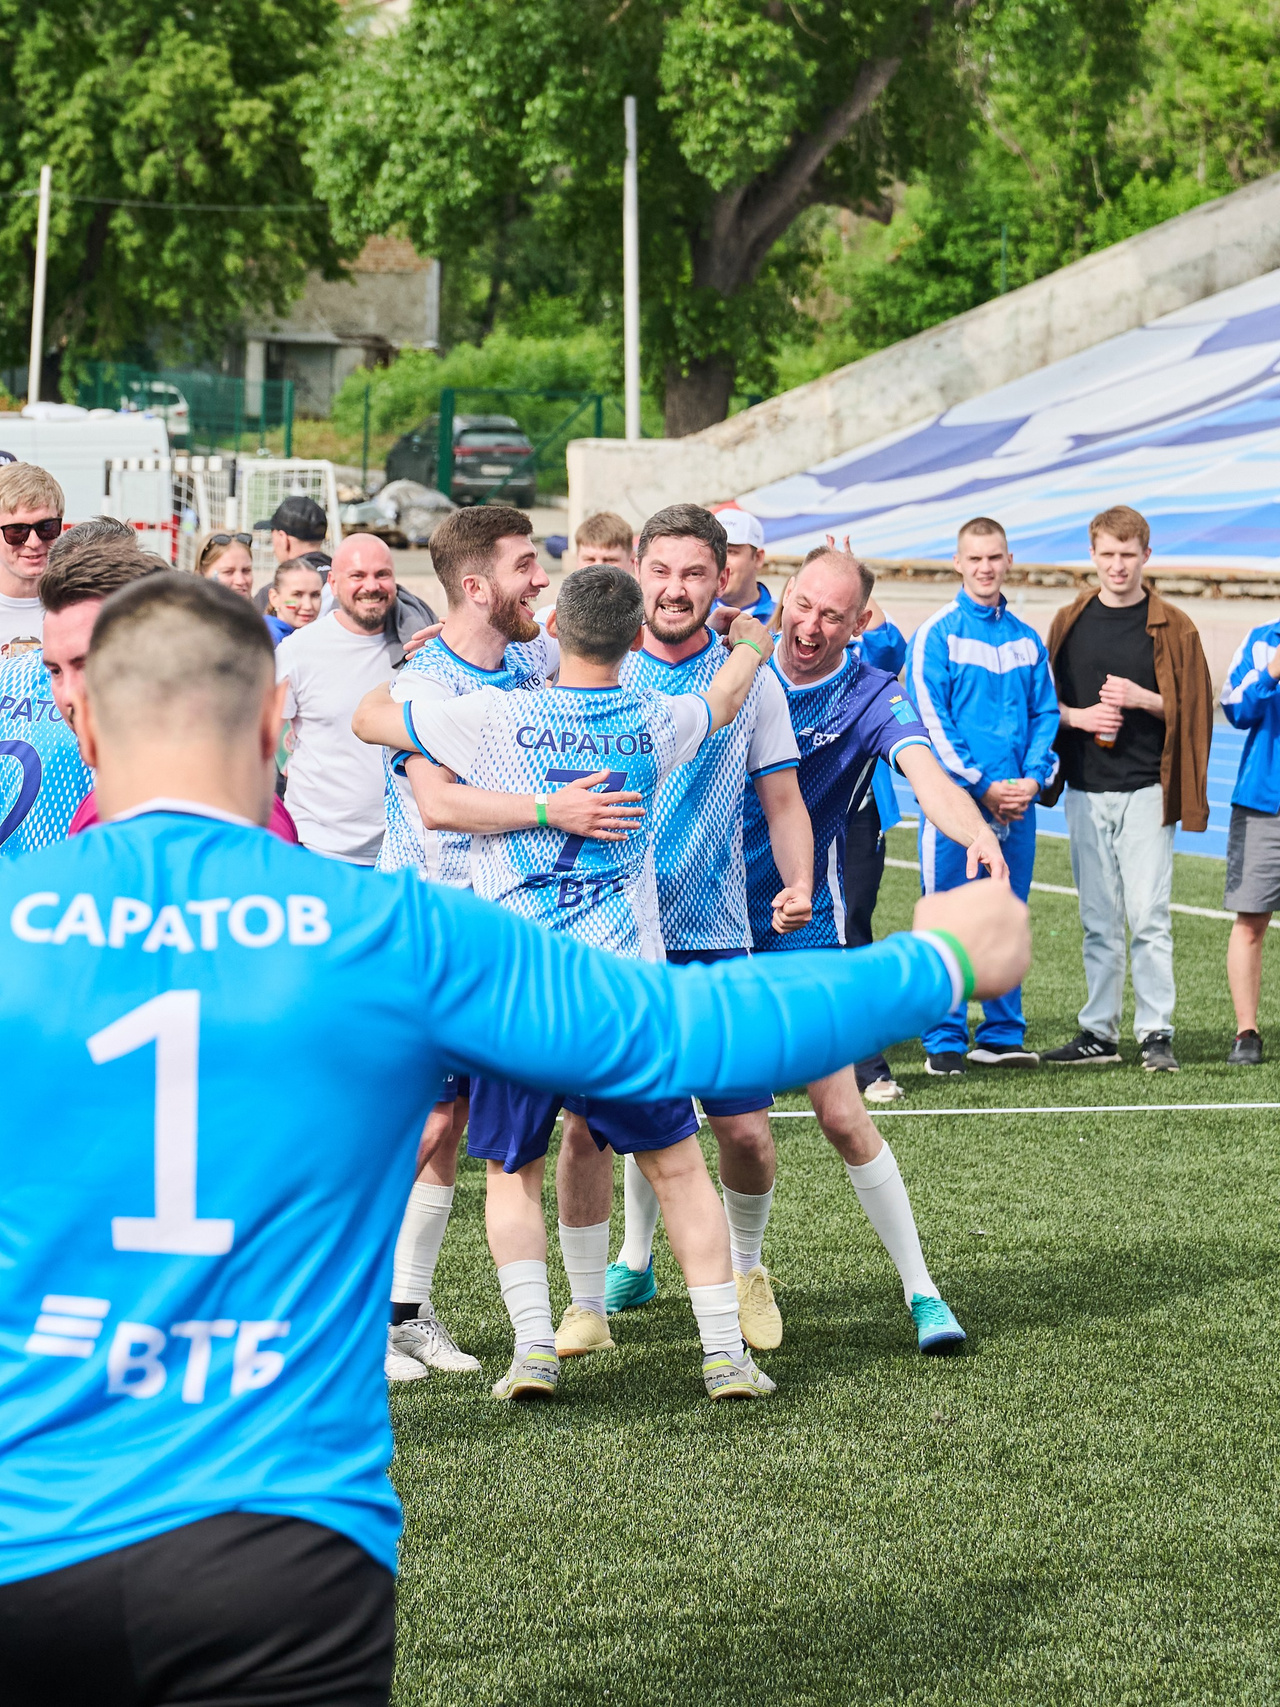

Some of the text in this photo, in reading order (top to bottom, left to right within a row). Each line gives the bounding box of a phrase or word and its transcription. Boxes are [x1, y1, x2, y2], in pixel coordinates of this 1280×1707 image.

[516, 726, 655, 756] САРАТОВ
[544, 768, 629, 872] 7
[10, 891, 333, 953] САРАТОВ
[86, 989, 235, 1256] 1
[107, 1318, 291, 1405] ВТБ
[522, 1365, 559, 1376] TOP-FLE
[705, 1371, 740, 1384] OP-FLEX
